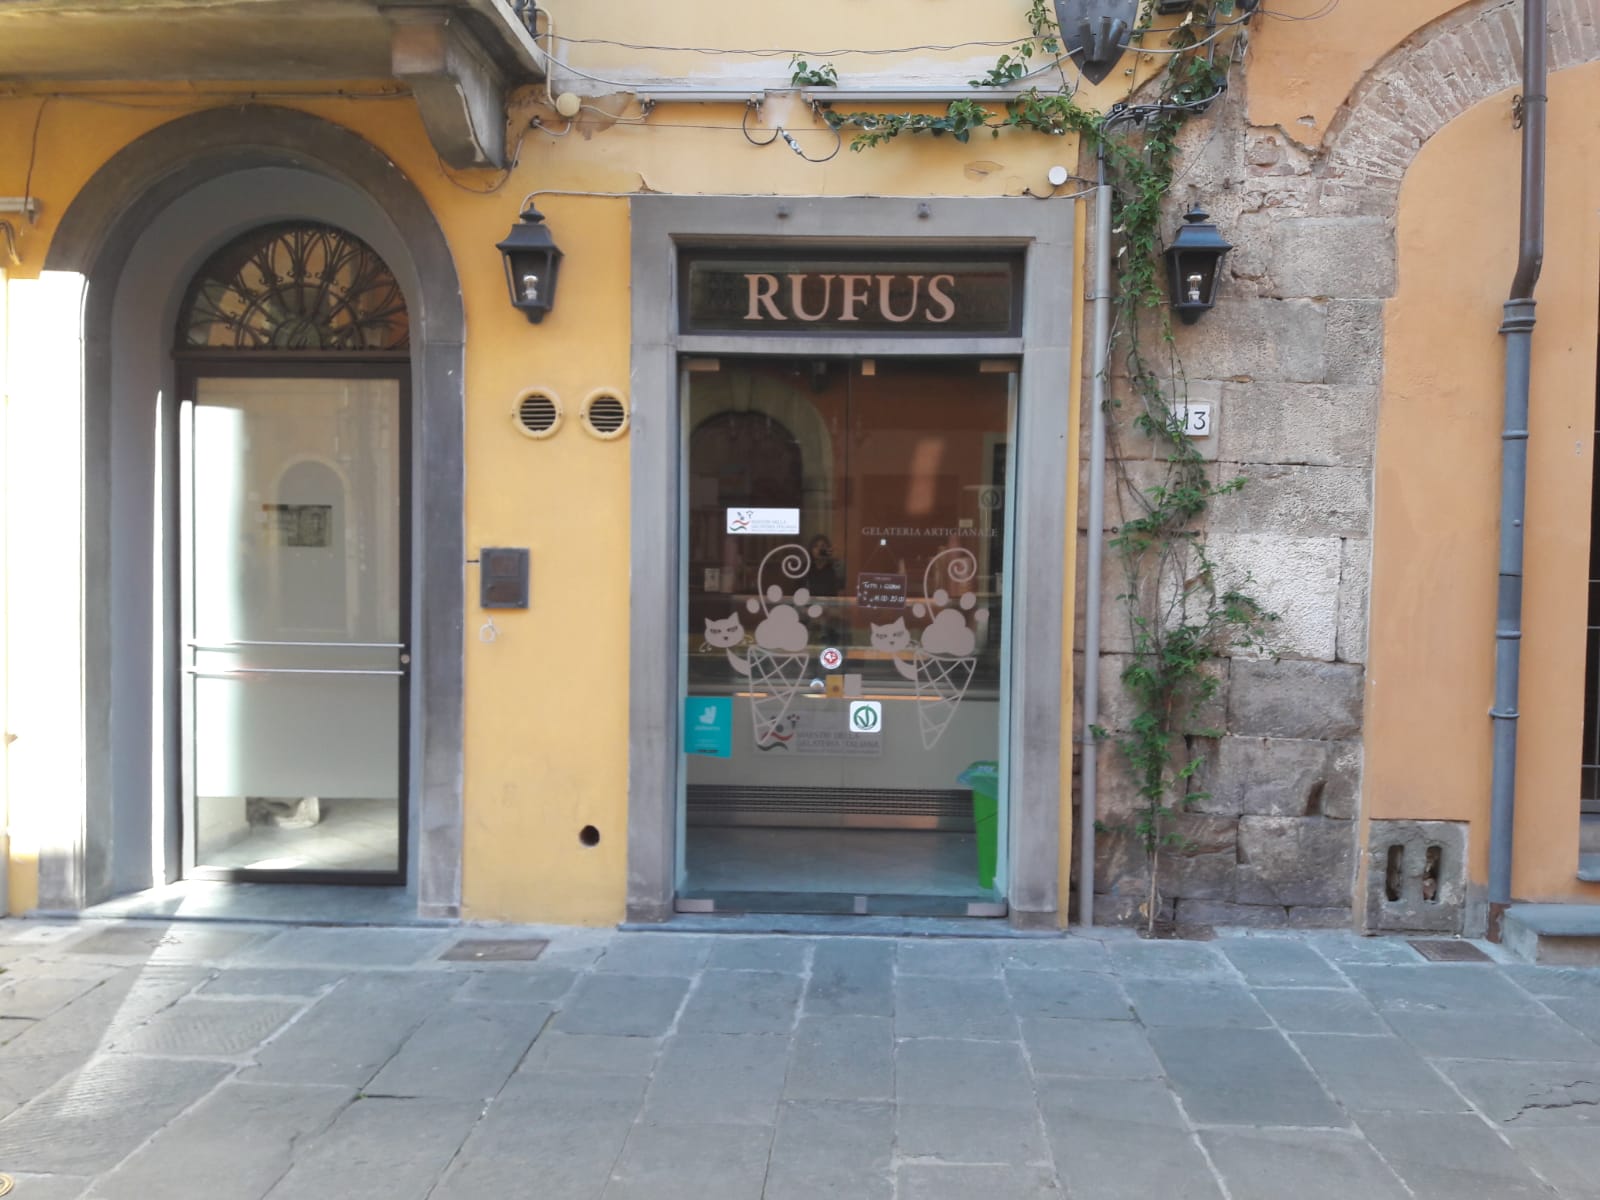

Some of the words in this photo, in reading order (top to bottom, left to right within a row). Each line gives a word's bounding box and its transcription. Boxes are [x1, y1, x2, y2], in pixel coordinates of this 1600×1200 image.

[743, 274, 955, 322] RUFUS
[861, 526, 921, 537] GELATERIA
[922, 526, 999, 538] ARTIGIANALE
